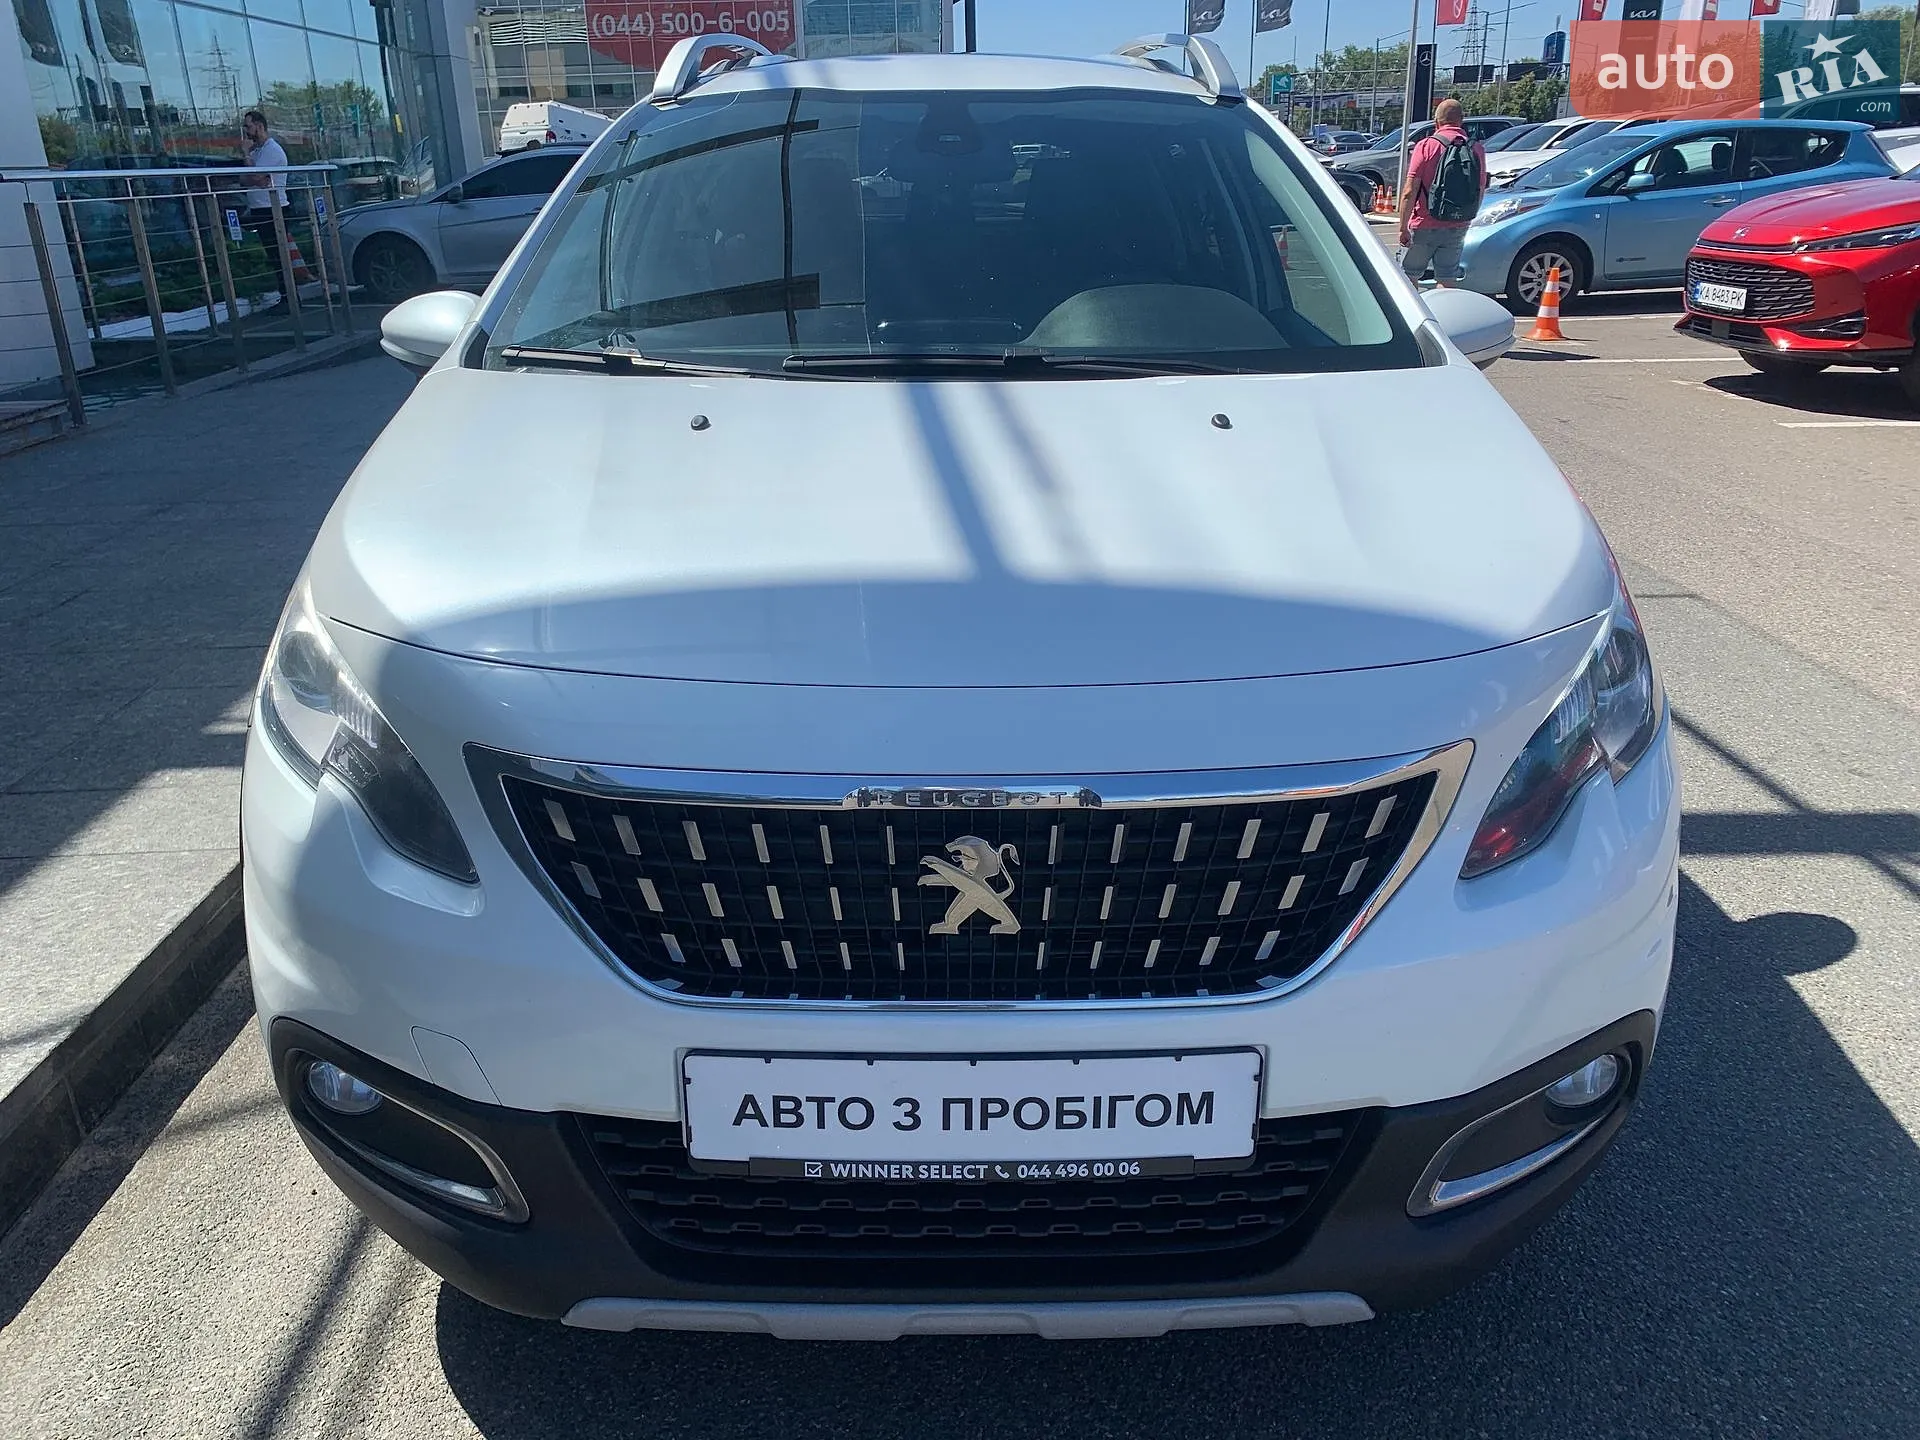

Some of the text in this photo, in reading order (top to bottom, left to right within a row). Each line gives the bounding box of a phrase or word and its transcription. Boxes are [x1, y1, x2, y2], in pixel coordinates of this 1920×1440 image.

[1629, 9, 1658, 18] KIA
[592, 10, 791, 38] (044) 500-6-005
[876, 790, 1068, 808] PEUGEOT
[732, 1091, 1215, 1132] АВТО З ПРОБІГОМ
[830, 1161, 1141, 1179] WINNER SELECT 044 496 00 06
